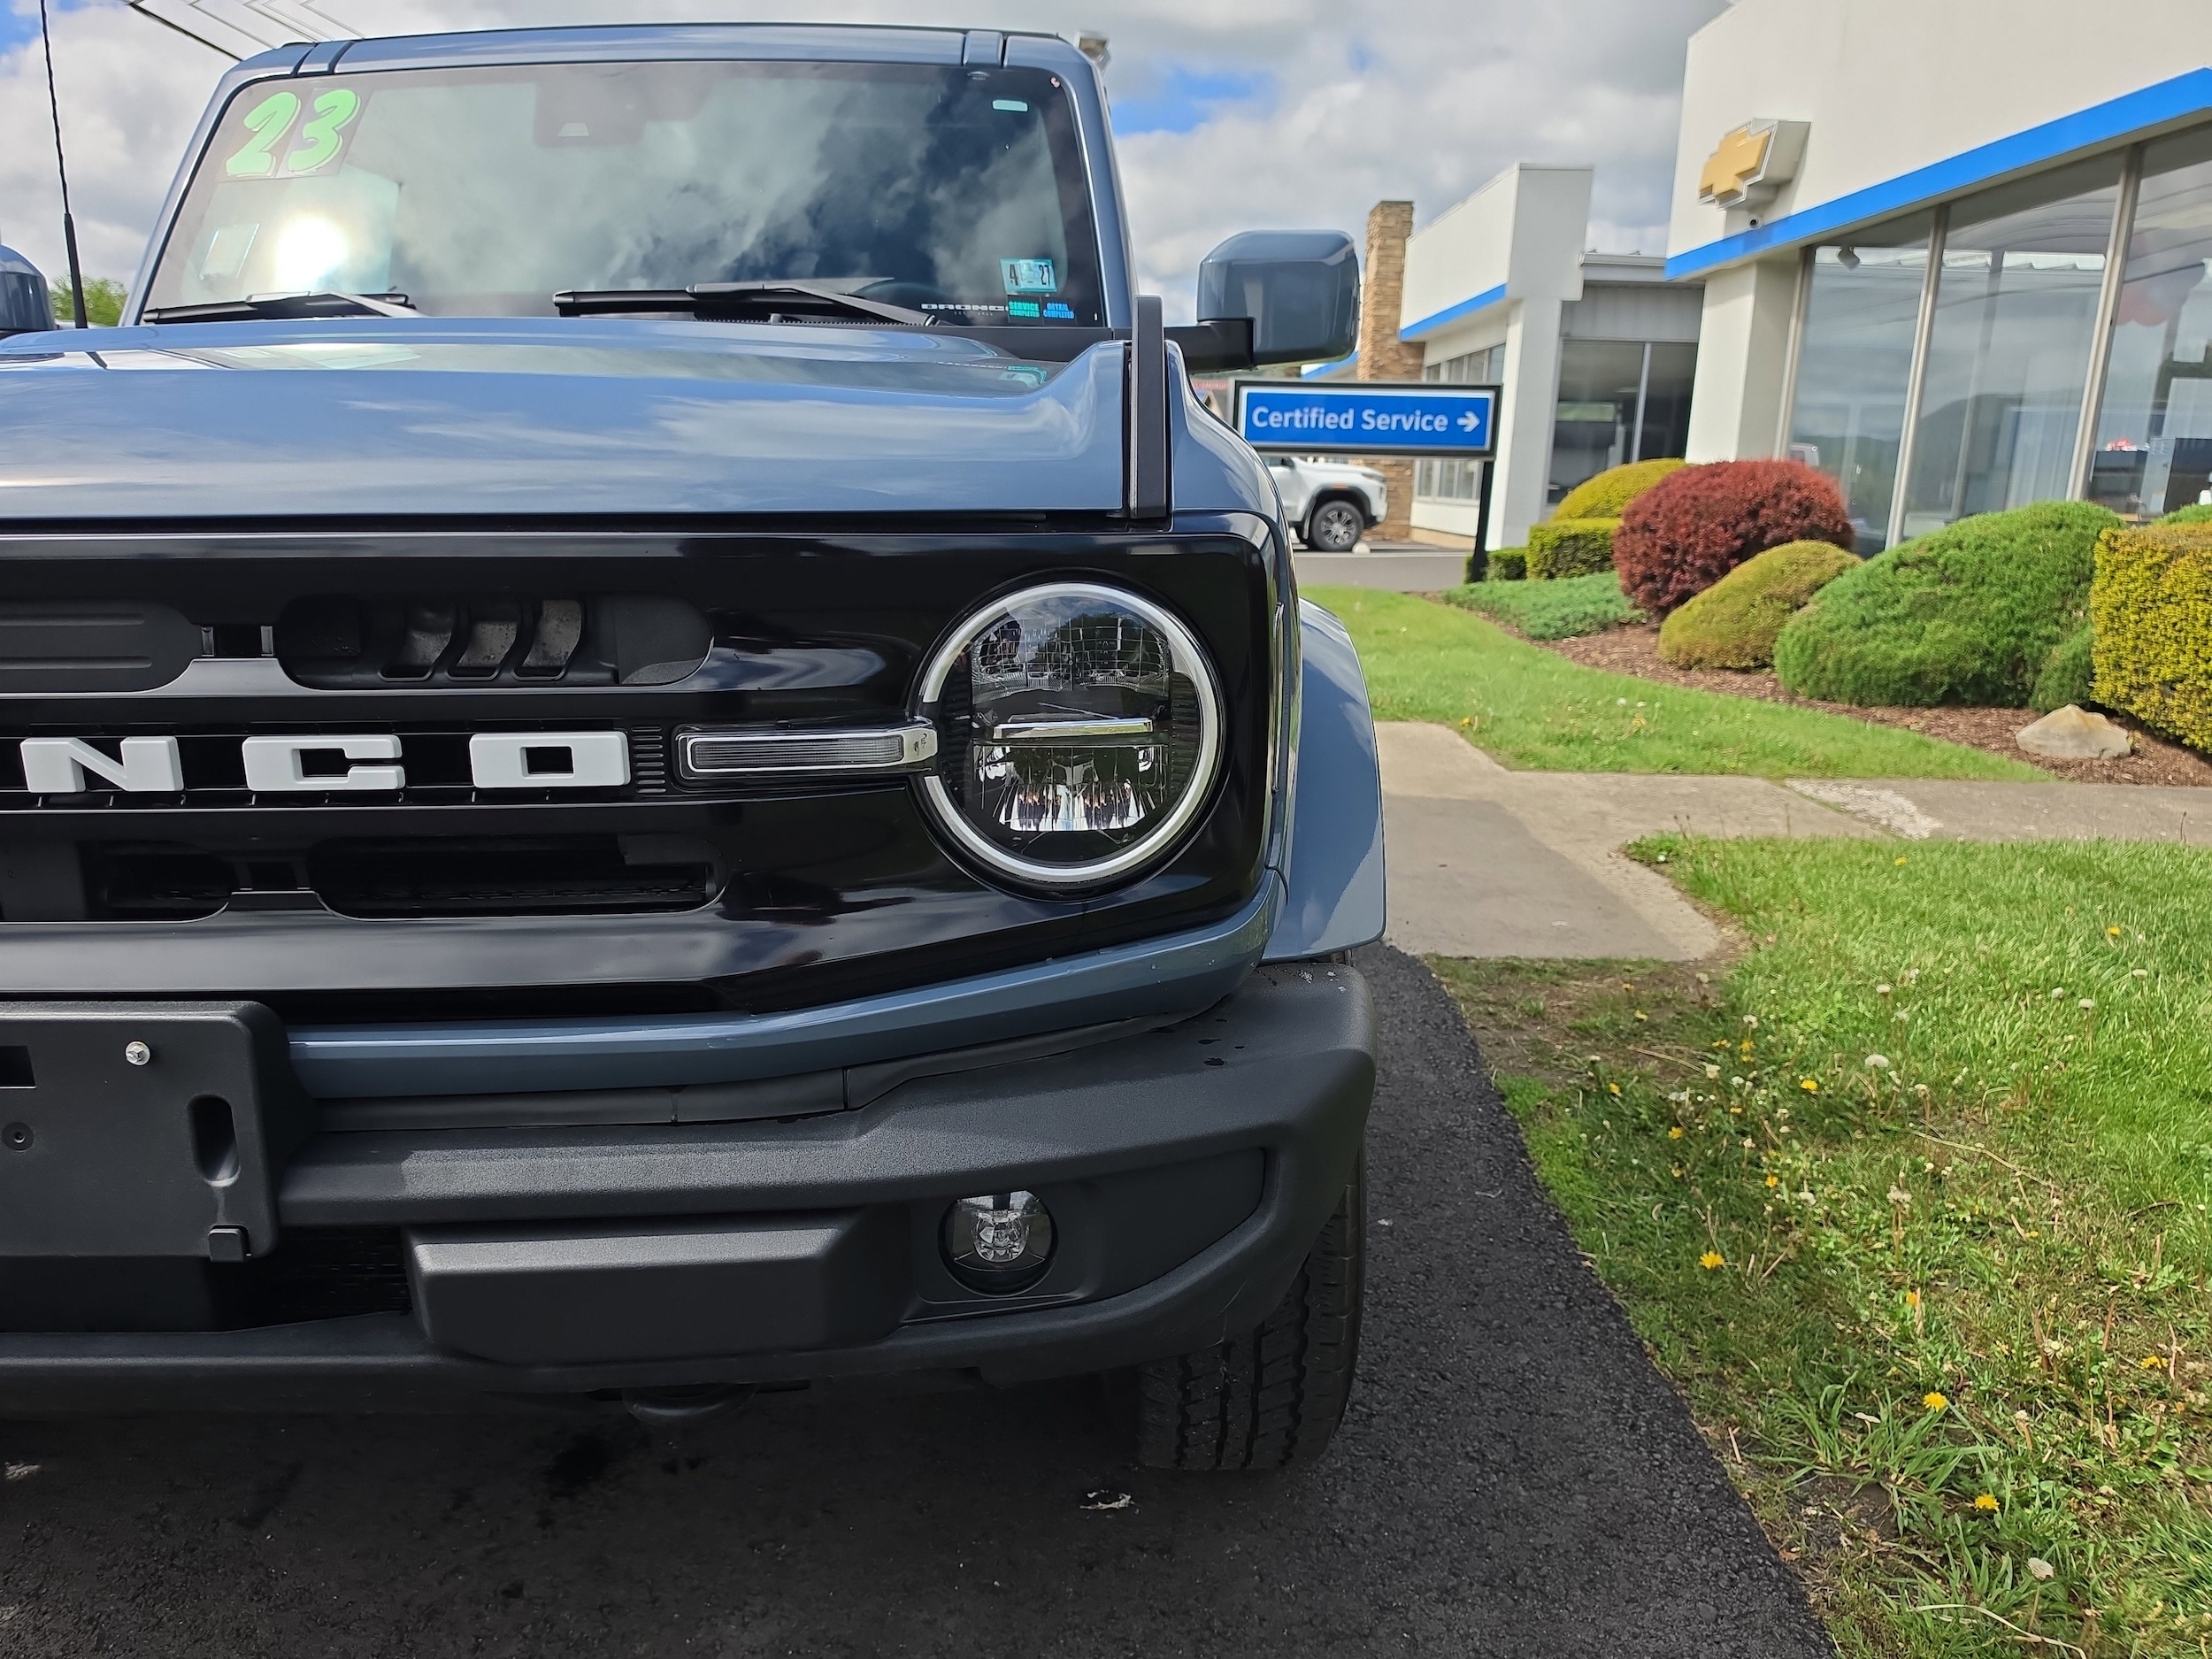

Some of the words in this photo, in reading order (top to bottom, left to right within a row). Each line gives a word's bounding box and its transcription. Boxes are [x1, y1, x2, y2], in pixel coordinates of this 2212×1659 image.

[226, 89, 360, 177] 23
[1010, 264, 1019, 287] 4
[1039, 264, 1051, 287] 27
[921, 303, 1009, 312] BRONC
[1009, 301, 1040, 311] SERVICE
[1046, 303, 1070, 312] DETAIL
[1251, 405, 1355, 430] Certified
[1361, 409, 1448, 432] Service
